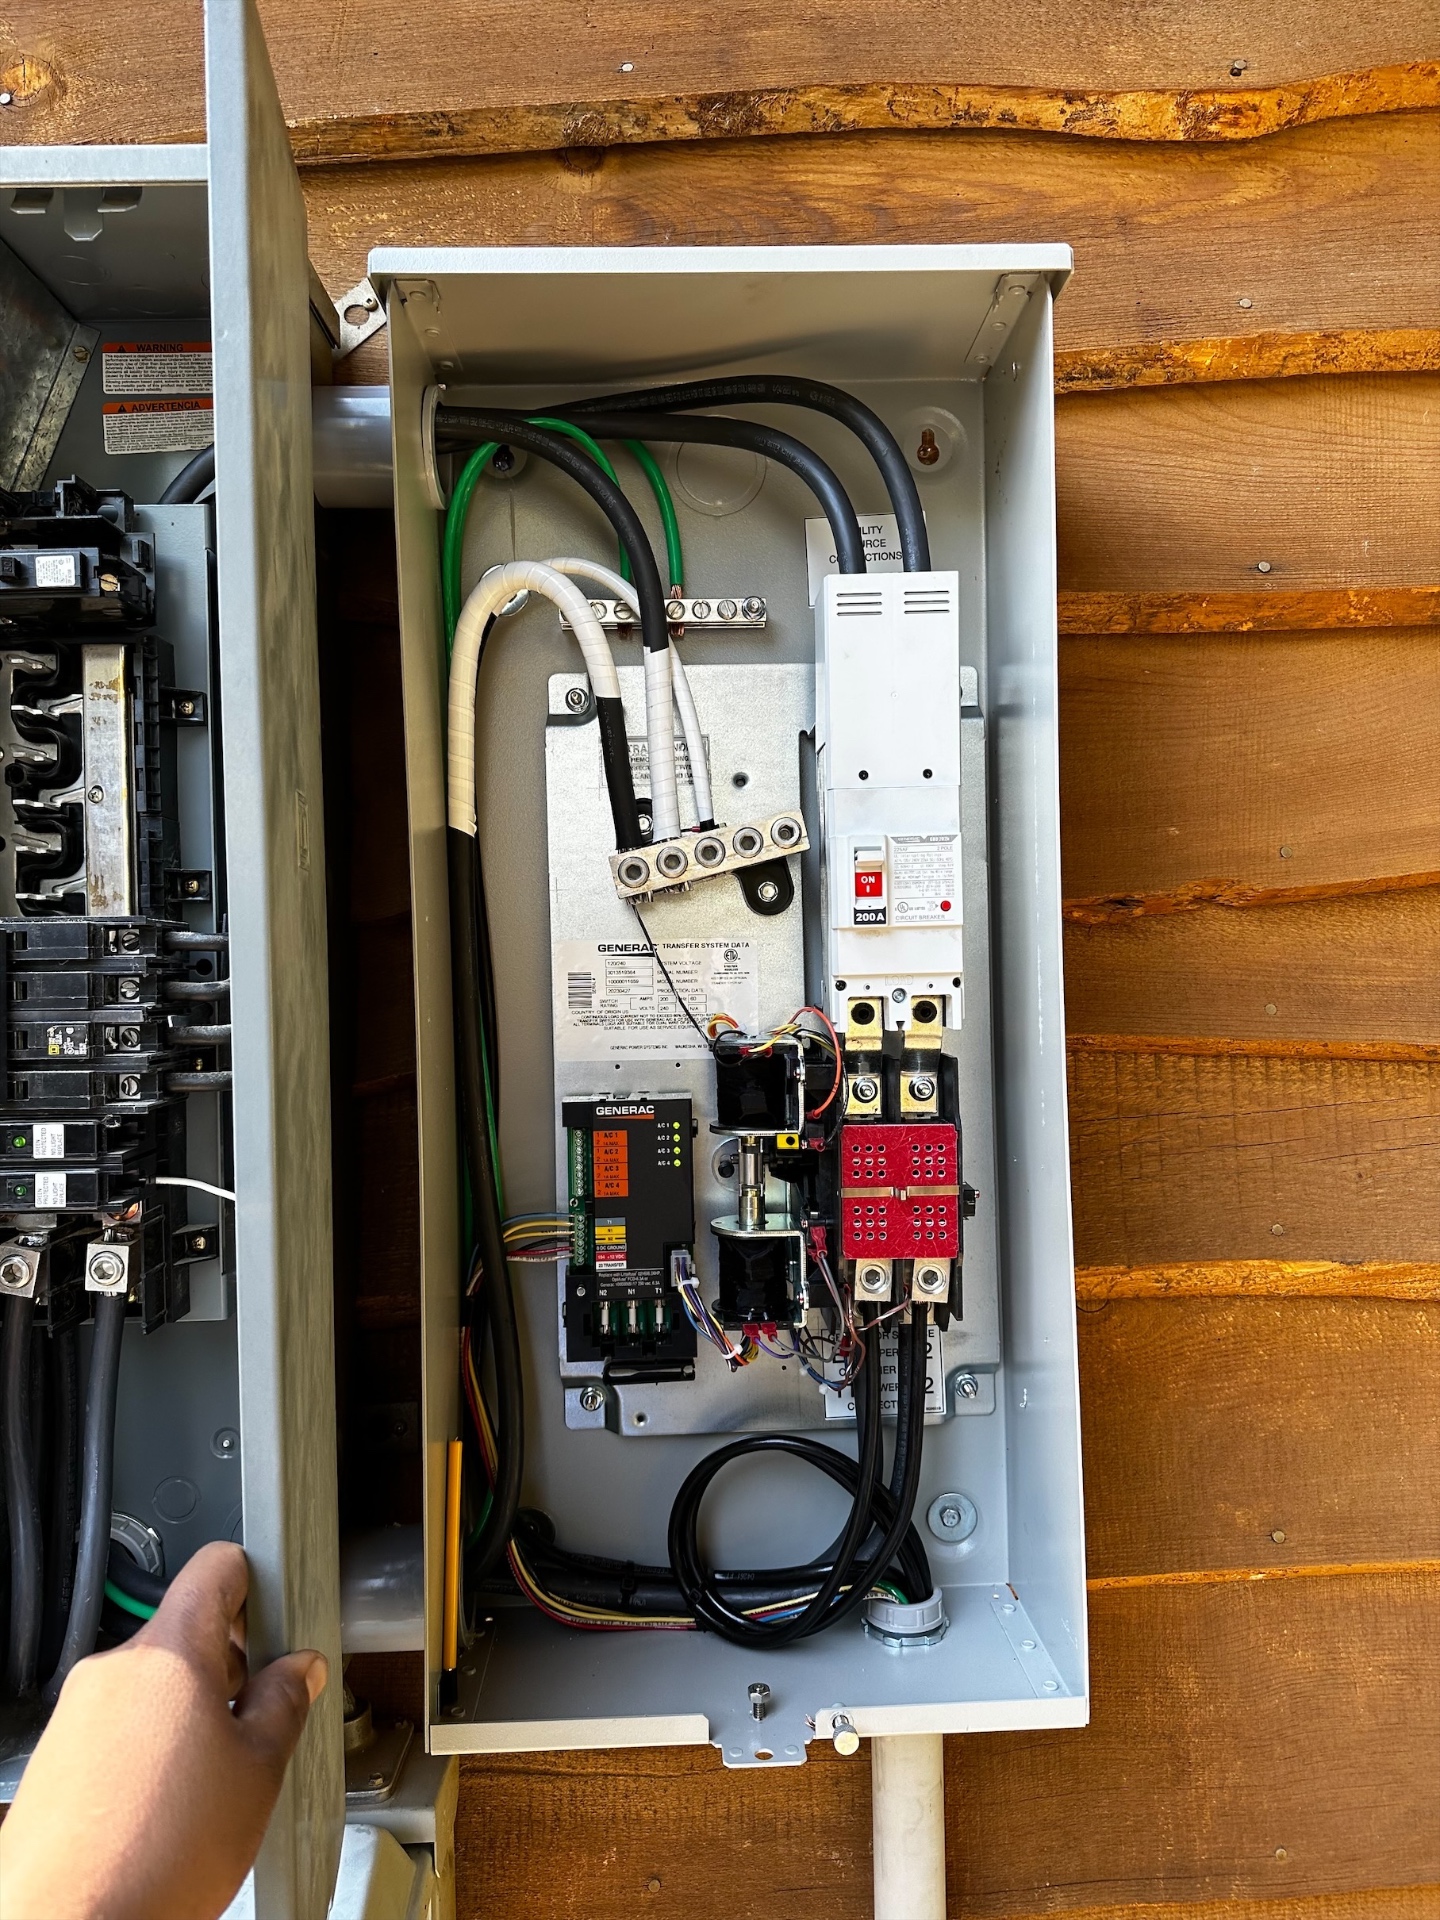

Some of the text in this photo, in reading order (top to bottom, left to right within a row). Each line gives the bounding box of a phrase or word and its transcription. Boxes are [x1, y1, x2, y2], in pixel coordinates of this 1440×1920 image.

[132, 401, 200, 412] ADVERTENCIA
[856, 913, 885, 921] 200A
[596, 1105, 655, 1115] GENERAC
